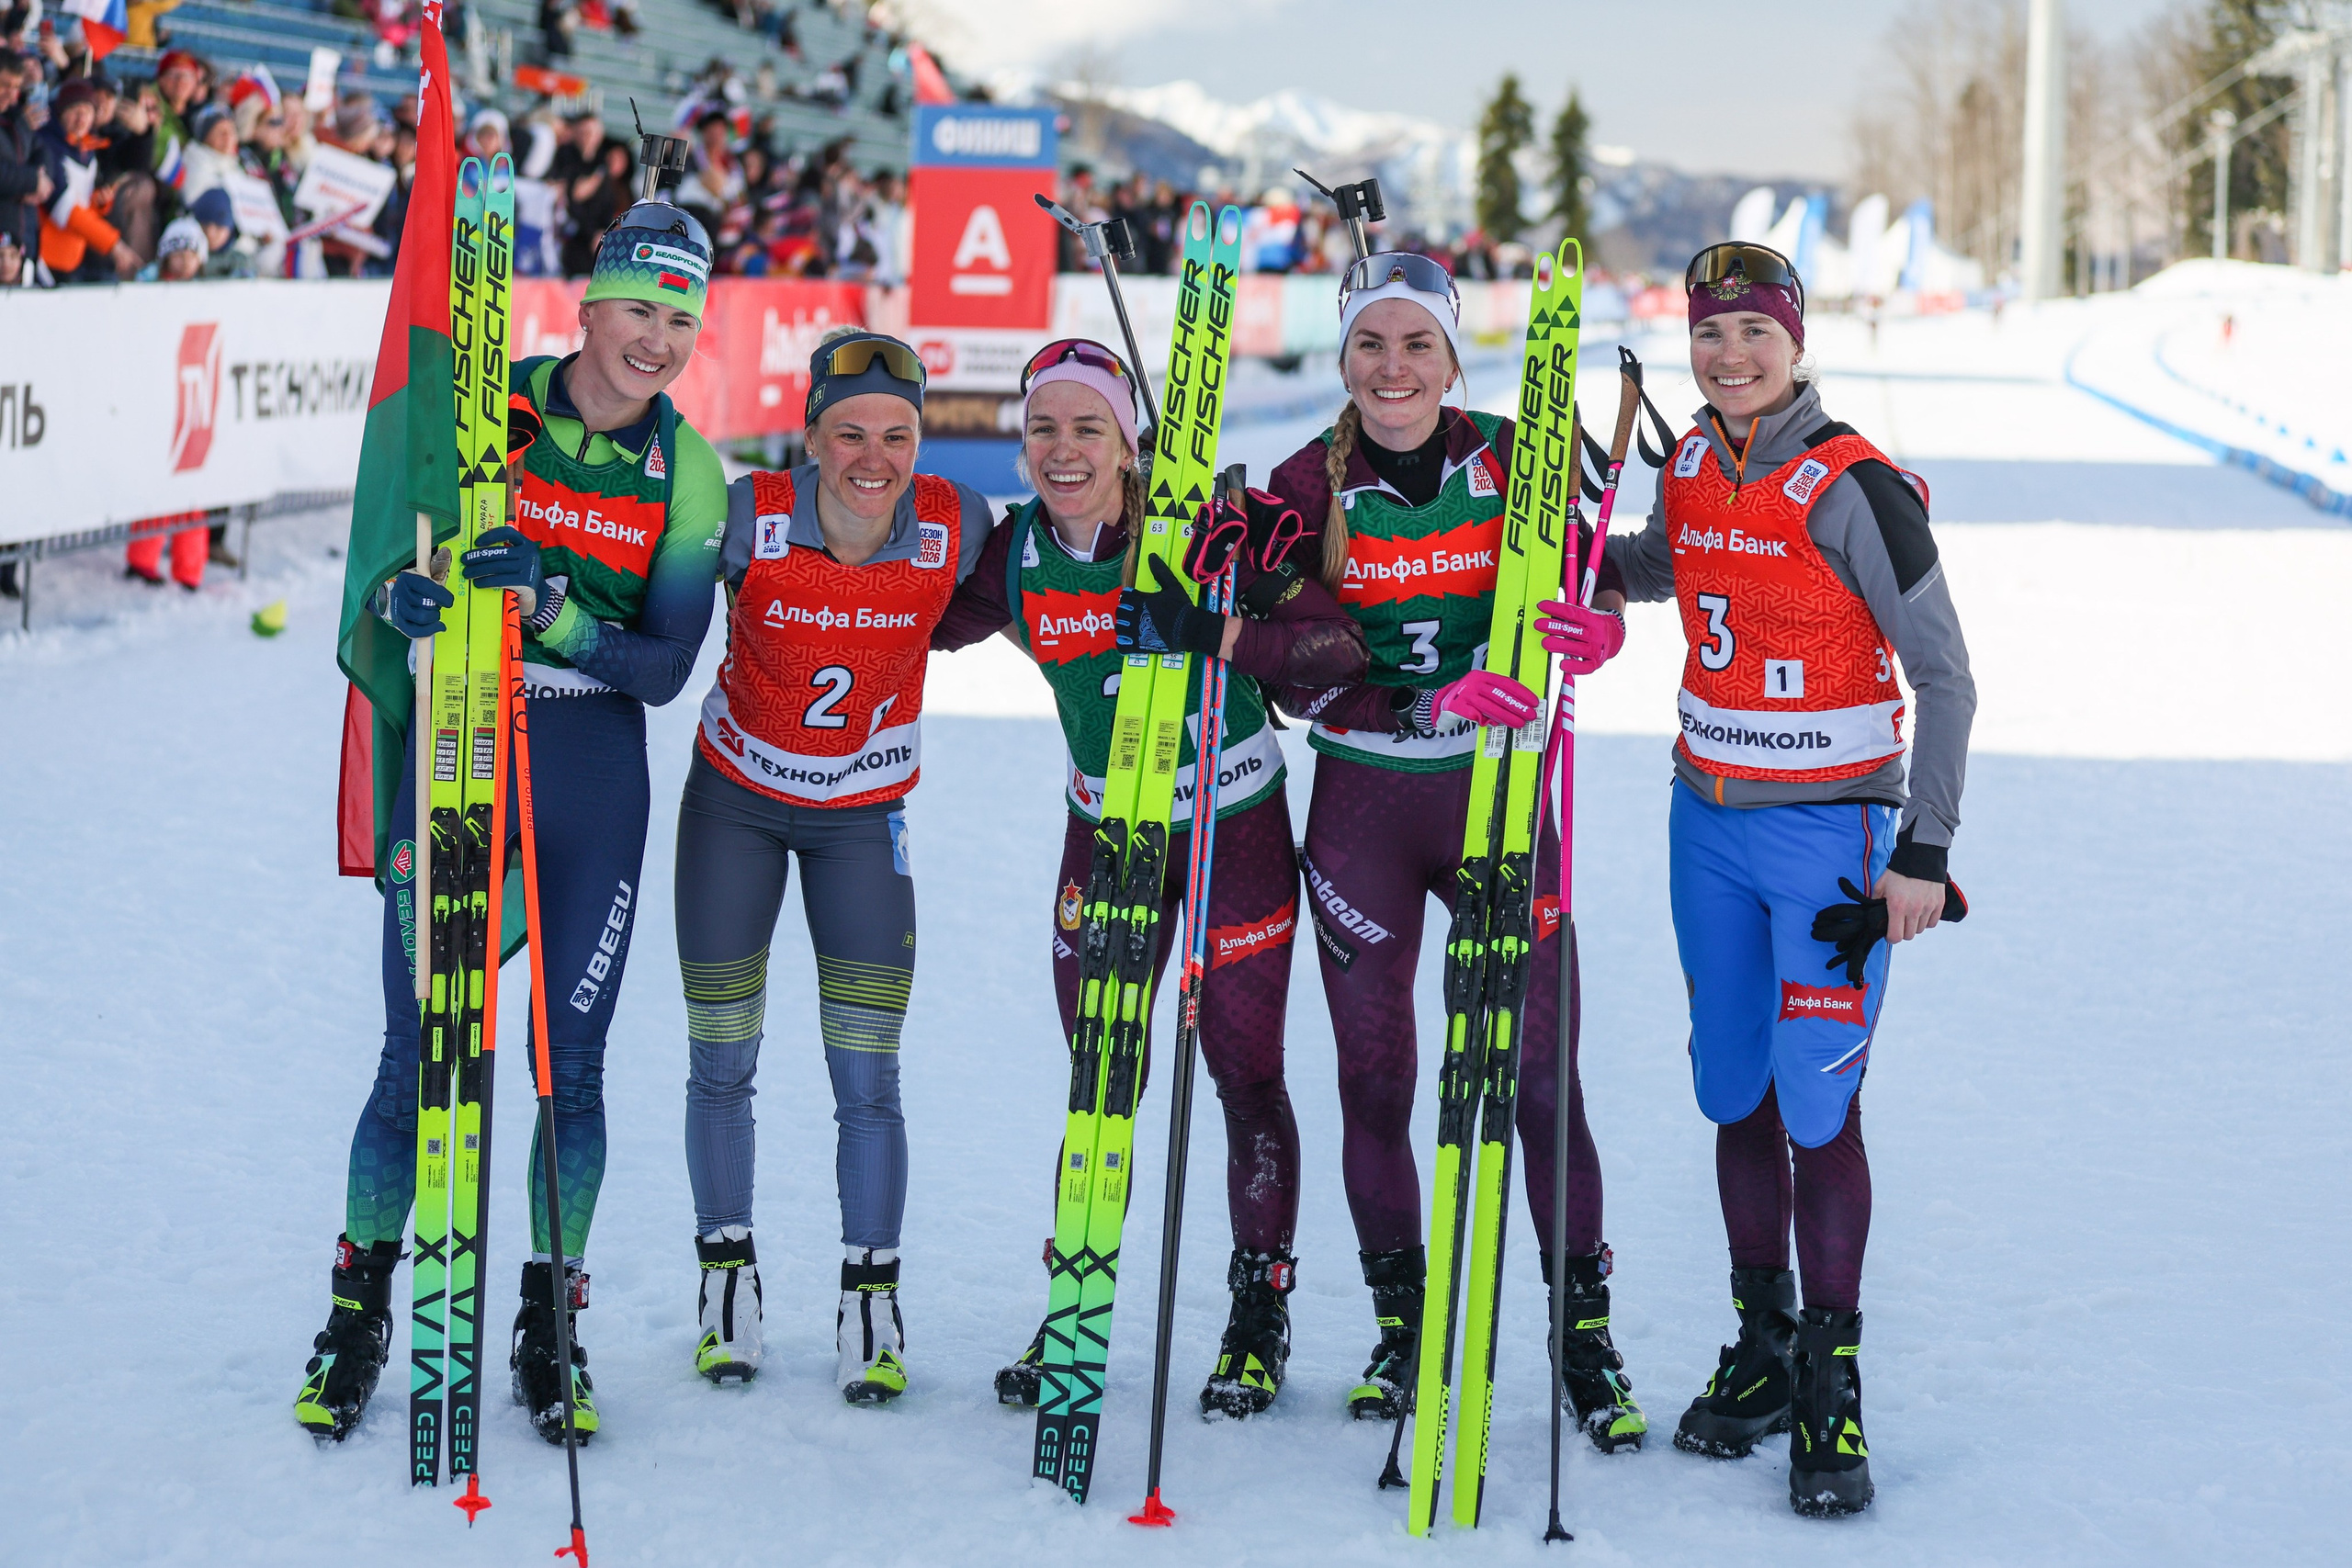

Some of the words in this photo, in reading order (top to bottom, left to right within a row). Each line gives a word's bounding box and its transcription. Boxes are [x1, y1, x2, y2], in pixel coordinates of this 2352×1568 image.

[932, 117, 1041, 158] ФИНИШ
[453, 217, 479, 433] FISCHER
[482, 210, 510, 428] FISCHER
[1161, 258, 1204, 463] FISCHER
[1191, 262, 1234, 468] FISCHER
[1507, 355, 1546, 557] FISCHER
[1538, 342, 1573, 549] FISCHER
[1787, 482, 1810, 499] 2026
[584, 512, 648, 547] Банк
[920, 539, 942, 551] 2025
[1152, 523, 1163, 533] 63
[1678, 522, 1724, 552] Альфа
[1728, 528, 1788, 558] Банк
[917, 551, 940, 563] 2026
[1344, 555, 1427, 583] Альфа
[1431, 548, 1495, 574] Банк
[765, 598, 850, 632] Альфа
[855, 607, 918, 629] Банк
[1038, 609, 1114, 637] Альфа
[1698, 592, 1736, 671] 3
[1399, 616, 1442, 674] 3
[1776, 665, 1788, 692] 1
[1875, 648, 1891, 682] 3
[801, 663, 854, 729] 2
[524, 767, 531, 781] 40
[749, 745, 912, 787] ТЕХНОНИКОЛЬ
[1304, 850, 1390, 944] roteam
[586, 879, 632, 982] BEEU
[1219, 930, 1266, 951] Альфа
[1267, 917, 1293, 937] Банк
[1787, 995, 1821, 1011] Альфа
[1824, 998, 1853, 1010] Банк
[700, 1258, 746, 1269] SCHER
[1737, 1376, 1768, 1401] FISCHER
[454, 1406, 471, 1472] PEED
[1039, 1427, 1058, 1475] EED
[1799, 1422, 1812, 1453] FISCHER
